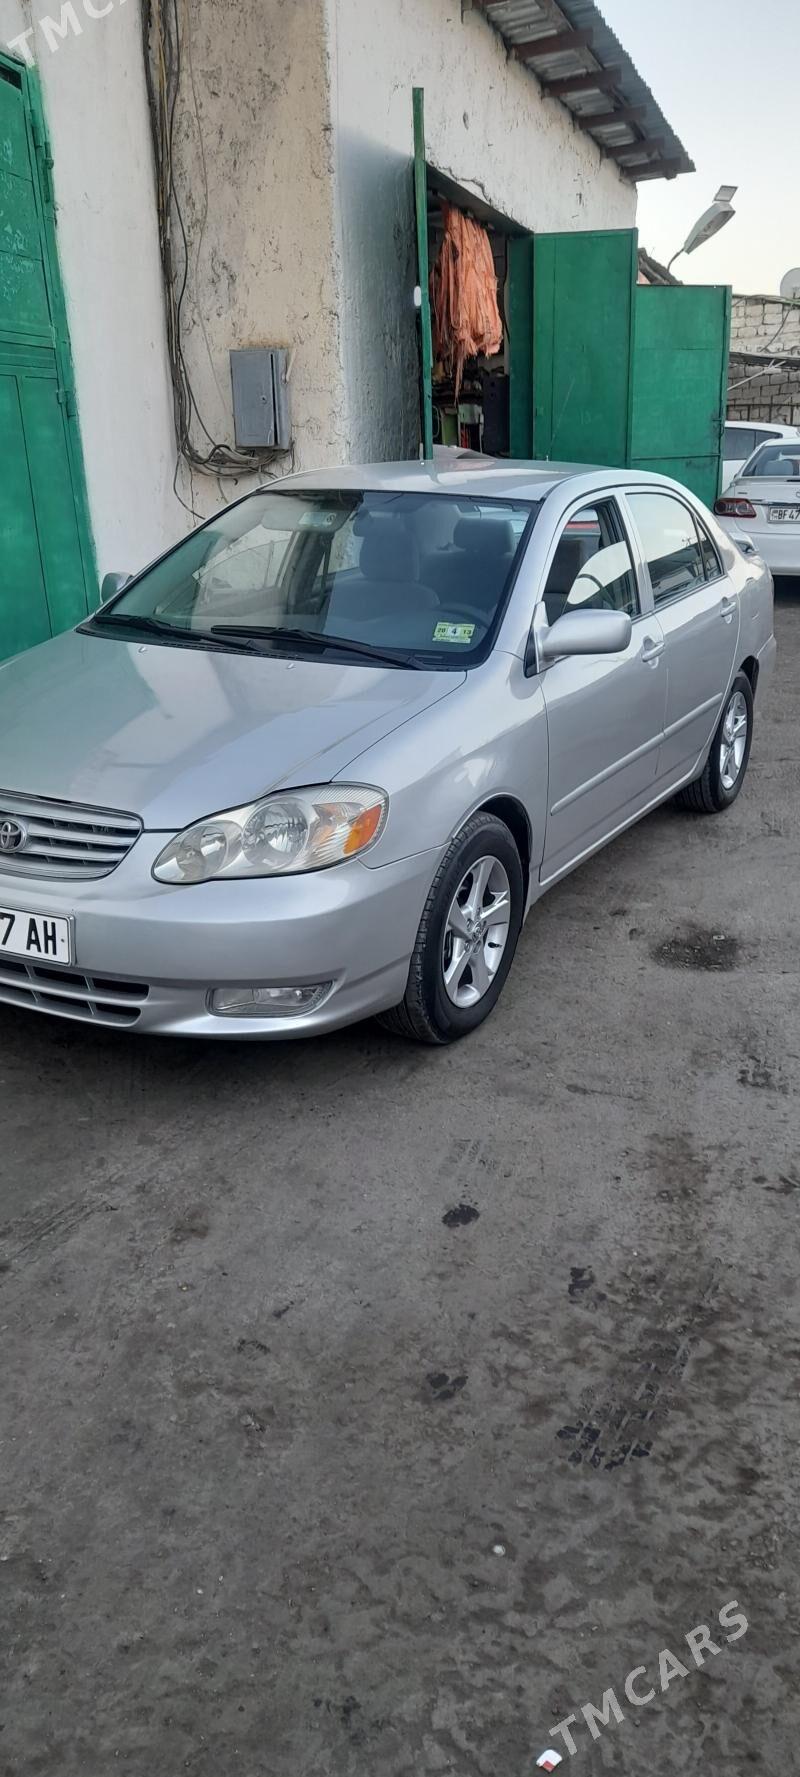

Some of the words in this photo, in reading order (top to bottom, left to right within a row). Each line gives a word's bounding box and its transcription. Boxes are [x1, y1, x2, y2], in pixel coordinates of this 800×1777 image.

[778, 510, 788, 519] BF
[0, 912, 15, 945] 7
[26, 917, 57, 955] AH
